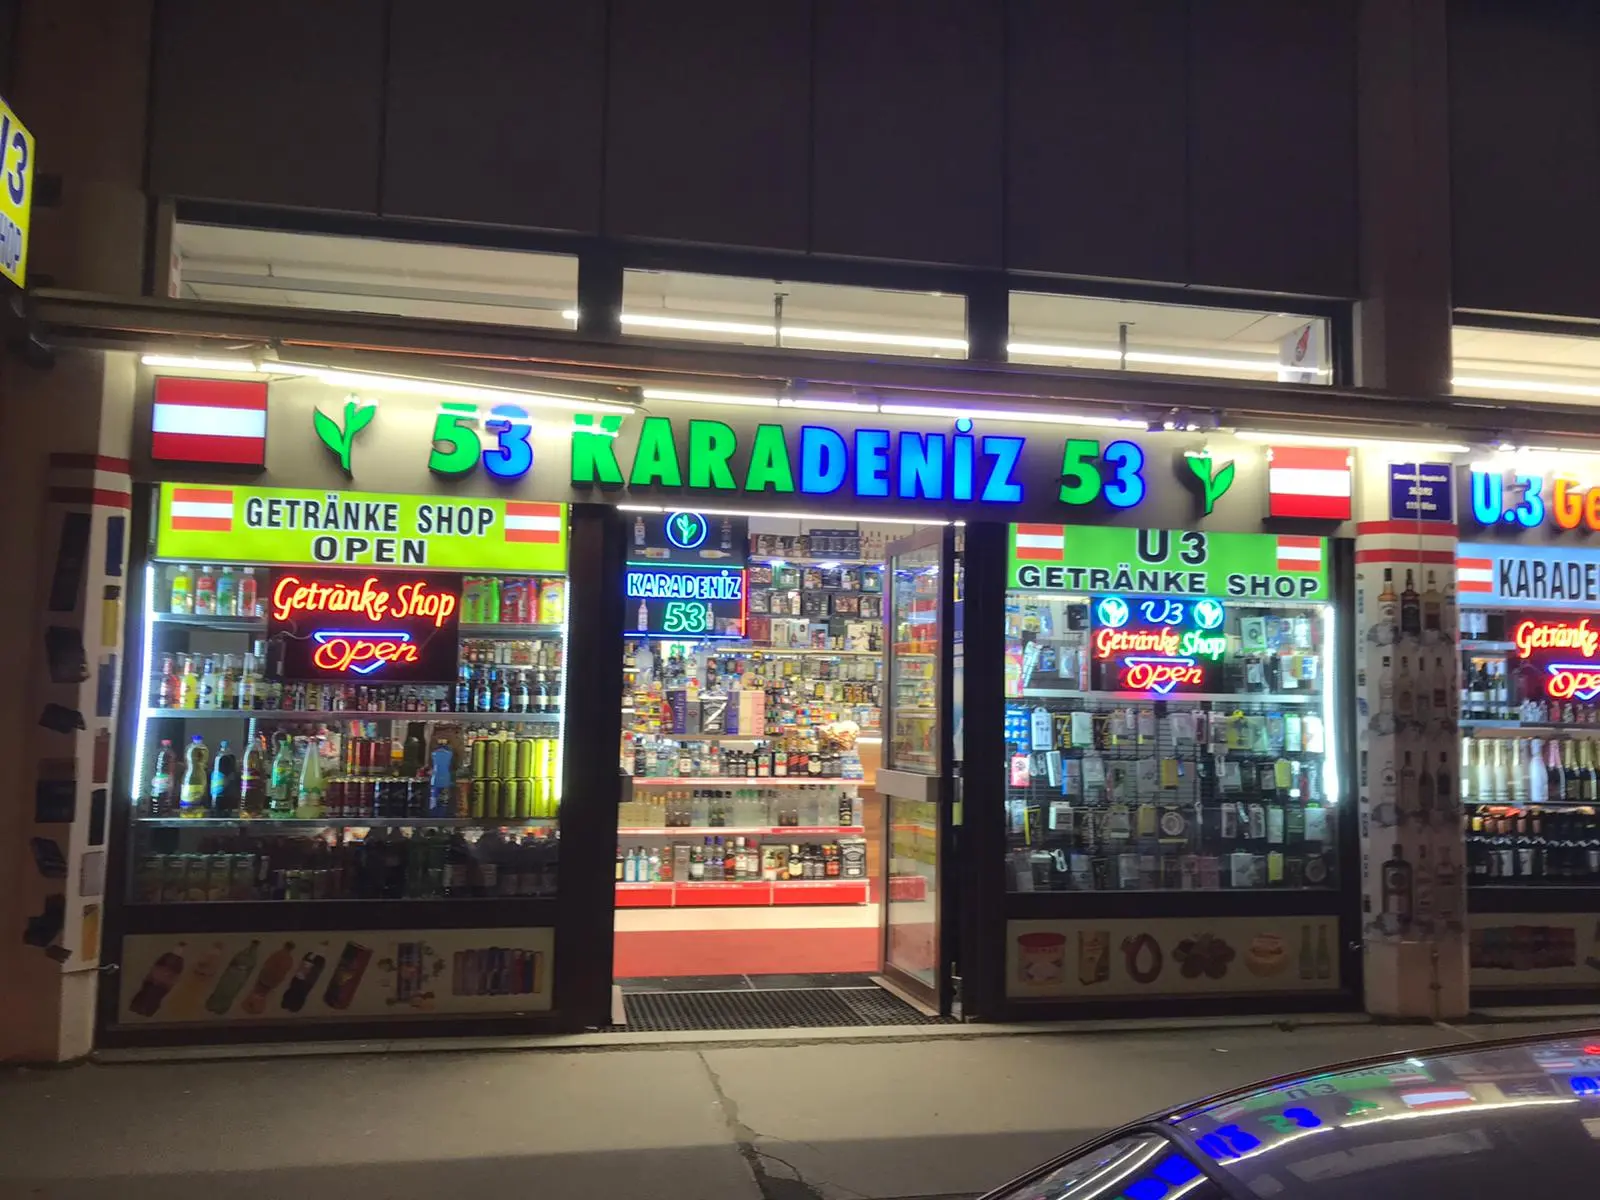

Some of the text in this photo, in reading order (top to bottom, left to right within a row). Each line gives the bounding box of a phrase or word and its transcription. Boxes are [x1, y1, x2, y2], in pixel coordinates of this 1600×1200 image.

[428, 402, 533, 478] 53
[1059, 439, 1146, 507] 53
[1471, 464, 1545, 528] U.3
[246, 494, 494, 535] GETRÄNKE SHOP
[314, 536, 427, 564] OPEN
[1018, 564, 1319, 598] GETRÄNKE SHOP
[273, 577, 455, 626] Getränke Shop
[664, 602, 706, 632] 53
[1140, 601, 1184, 625] U3
[314, 637, 418, 672] Open
[1097, 628, 1226, 660] Getränke Shop
[1517, 619, 1598, 659] Getränke
[1127, 665, 1203, 689] Open
